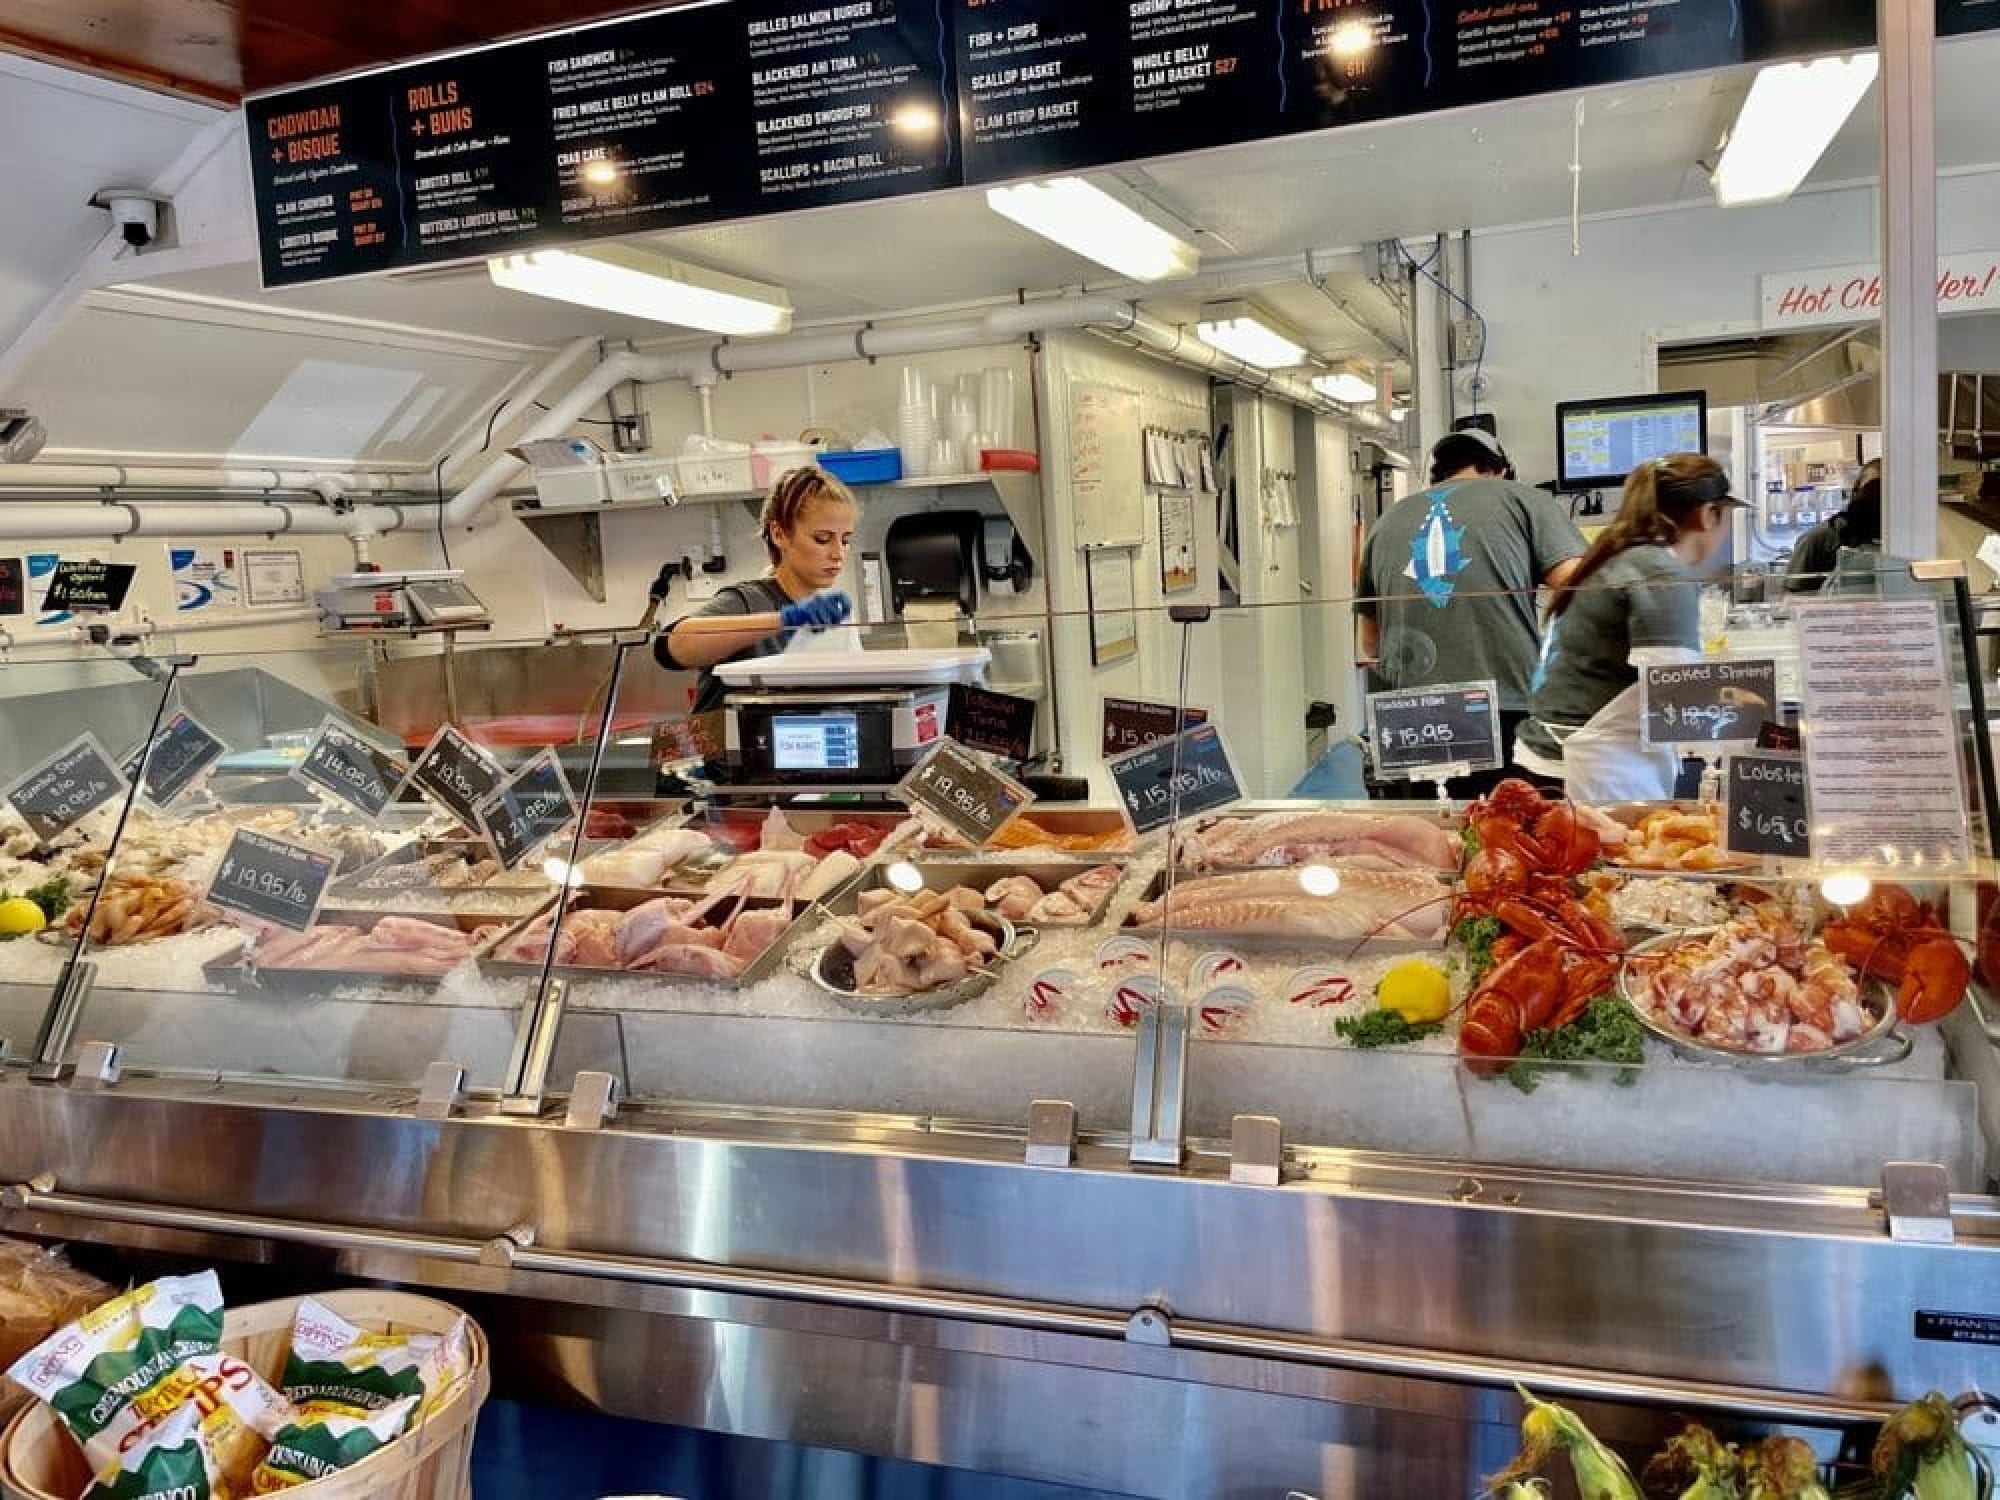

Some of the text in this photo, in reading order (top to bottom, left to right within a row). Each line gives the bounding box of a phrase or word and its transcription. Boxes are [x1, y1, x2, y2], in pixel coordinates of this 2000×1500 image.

[790, 9, 831, 28] SALMON
[970, 32, 992, 49] FISH
[548, 59, 568, 74] FISH
[1133, 44, 1209, 71] WHOLE BELLY
[752, 63, 809, 85] BLACKENED
[972, 61, 1061, 90] SCALLOP BASKET
[1134, 71, 1164, 88] CLAM
[1167, 62, 1212, 83] BASKET
[408, 81, 458, 112] ROLLS
[612, 94, 638, 109] BELLY
[642, 90, 666, 104] CLAM
[412, 107, 472, 136] + BUNS
[756, 113, 812, 134] BLACKENED
[976, 114, 1002, 131] CLAM
[1038, 100, 1079, 120] BASKET
[272, 132, 340, 163] + BISQUE
[1778, 266, 1996, 316] Hot Chder!
[1650, 666, 1773, 685] Cooked Shrimp
[1664, 703, 1676, 726] $
[1382, 727, 1393, 749] $
[1738, 762, 1804, 784] Lobste
[1127, 789, 1139, 810] $
[1739, 806, 1808, 843] $ 65.0
